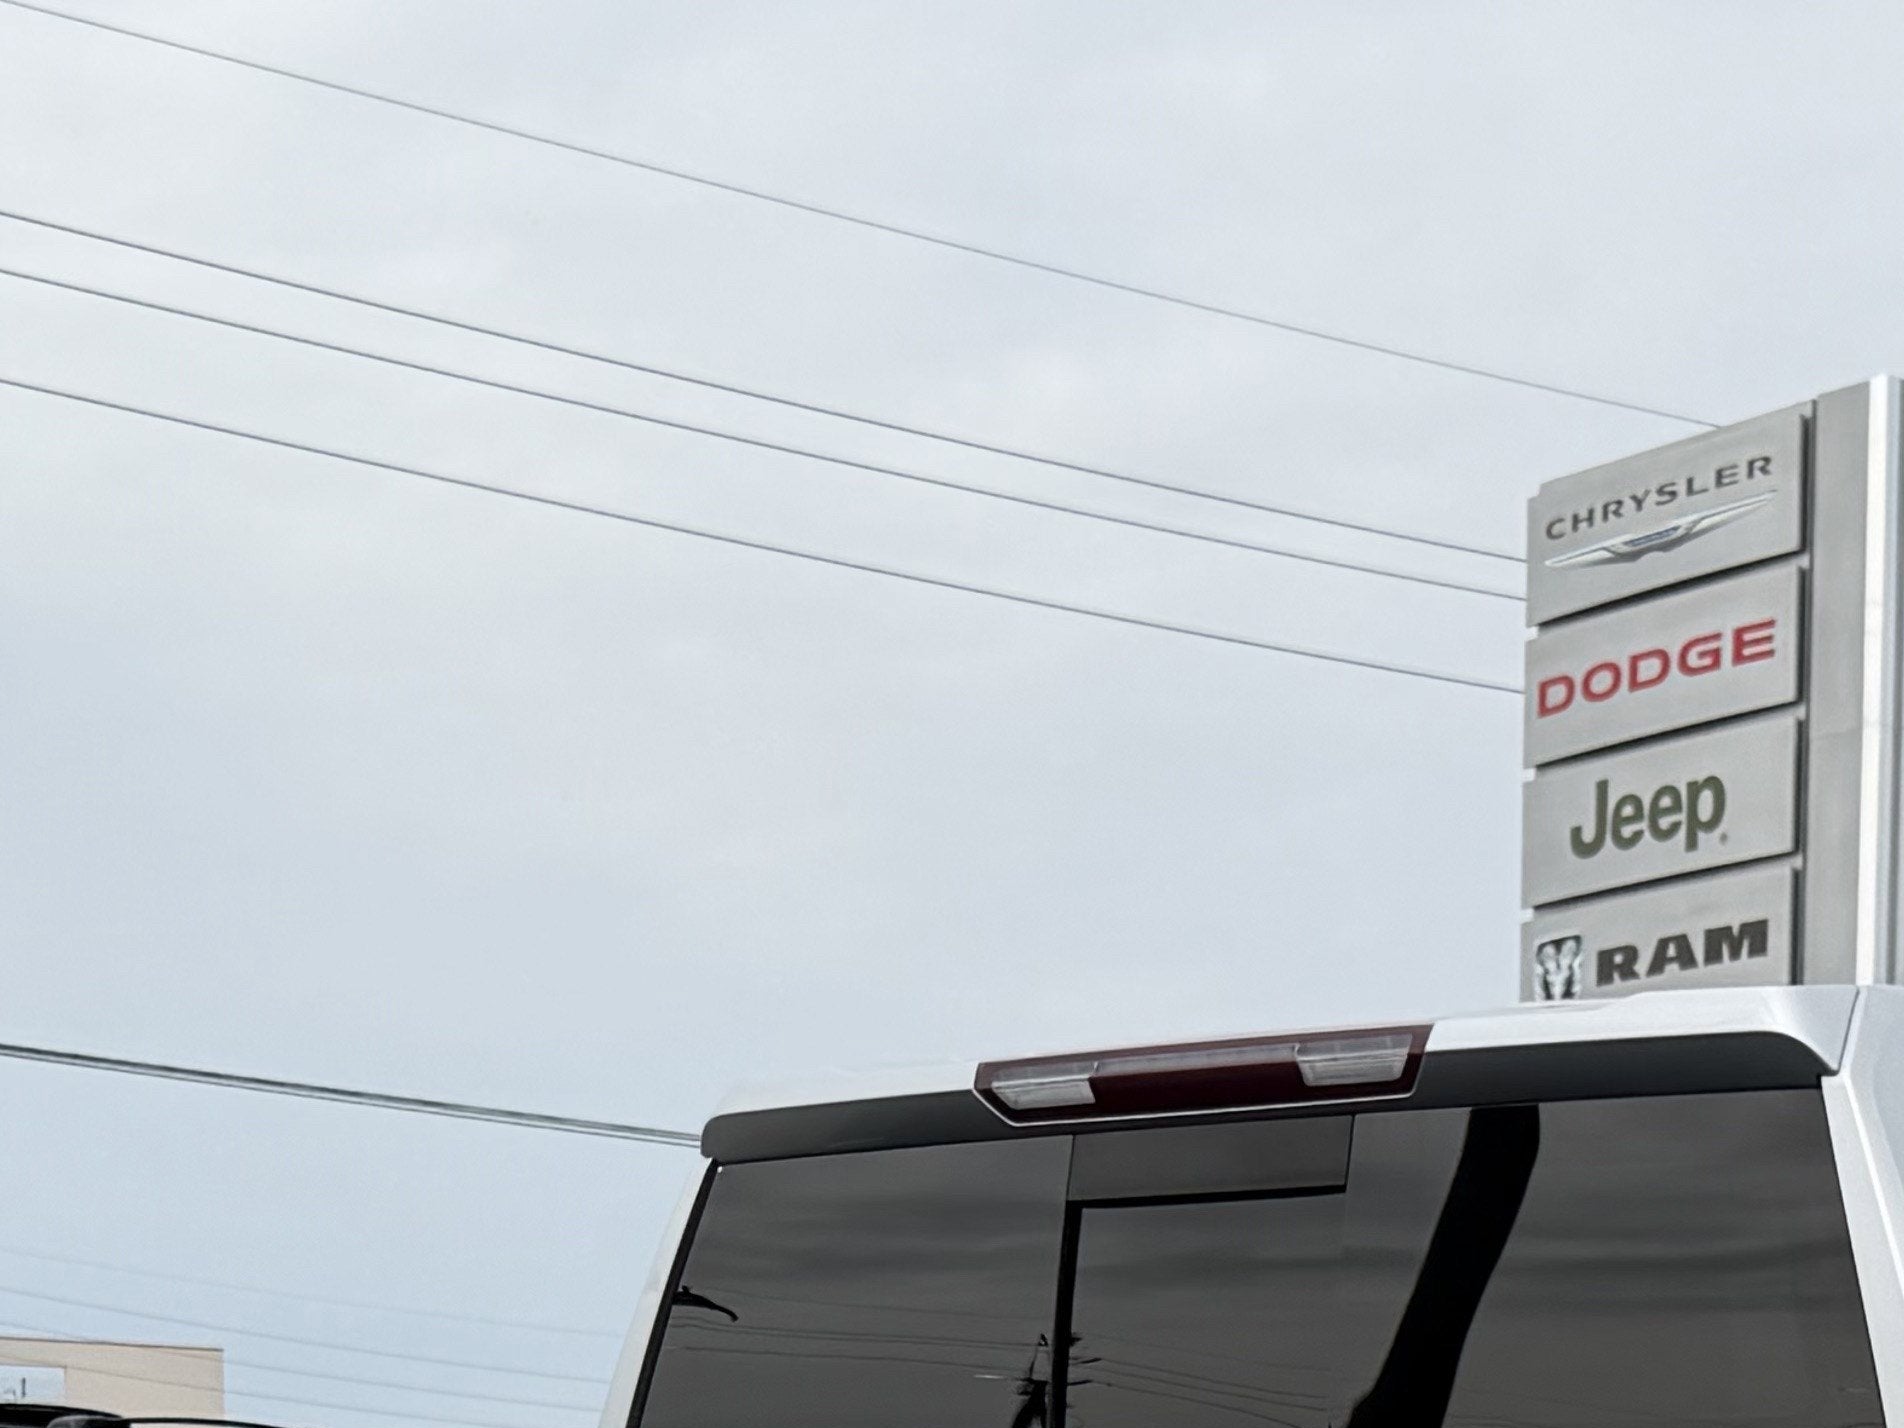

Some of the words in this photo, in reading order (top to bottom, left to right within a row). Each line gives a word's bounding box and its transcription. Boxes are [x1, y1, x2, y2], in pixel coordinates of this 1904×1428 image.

[1545, 454, 1774, 540] CHRYSLER
[1537, 618, 1776, 717] DODGE
[1570, 773, 1727, 860] Jeep
[1596, 918, 1769, 988] RAM
